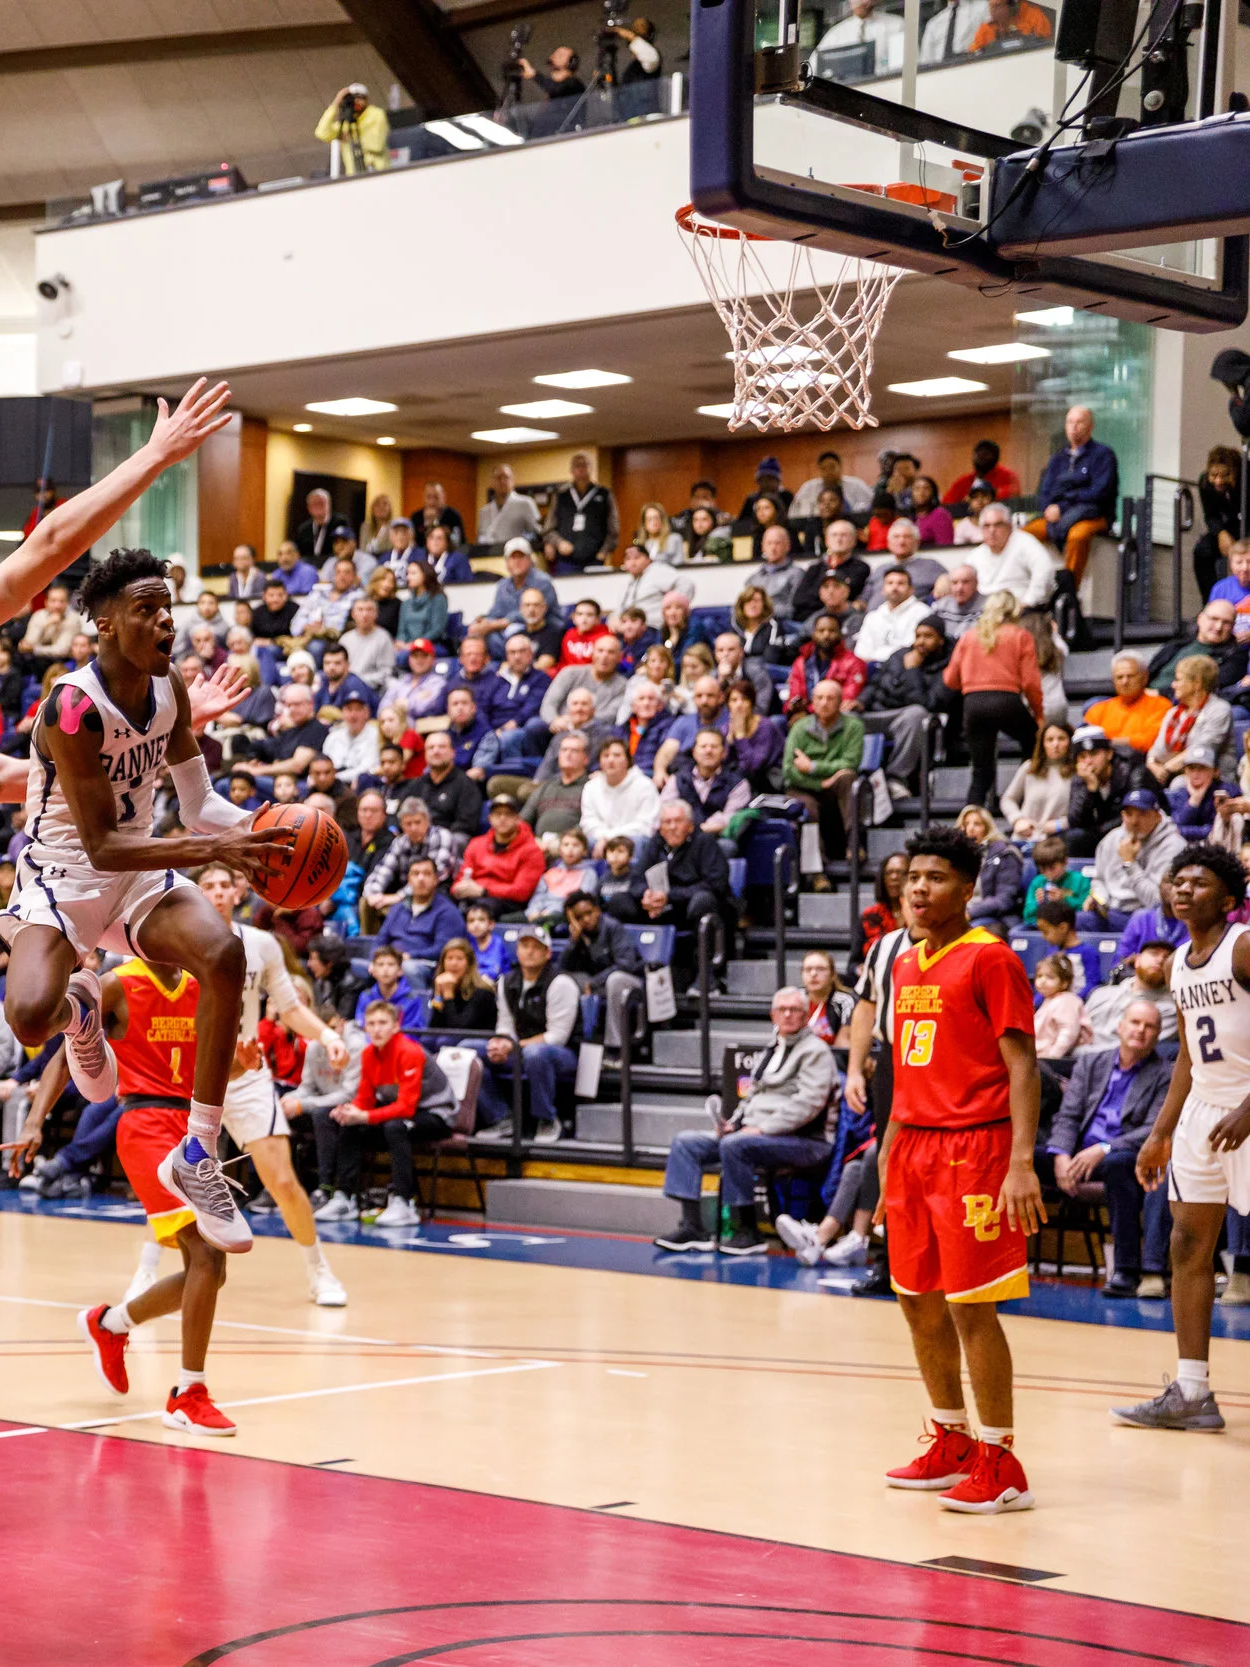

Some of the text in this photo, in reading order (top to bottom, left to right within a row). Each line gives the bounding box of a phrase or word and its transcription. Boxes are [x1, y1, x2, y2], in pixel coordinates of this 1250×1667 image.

[895, 998, 943, 1014] CATHOLIC
[900, 985, 941, 999] BERGEN
[900, 1019, 938, 1067] 13
[1196, 1015, 1224, 1064] 2
[170, 1046, 183, 1084] 1
[961, 1194, 1001, 1242] BC
